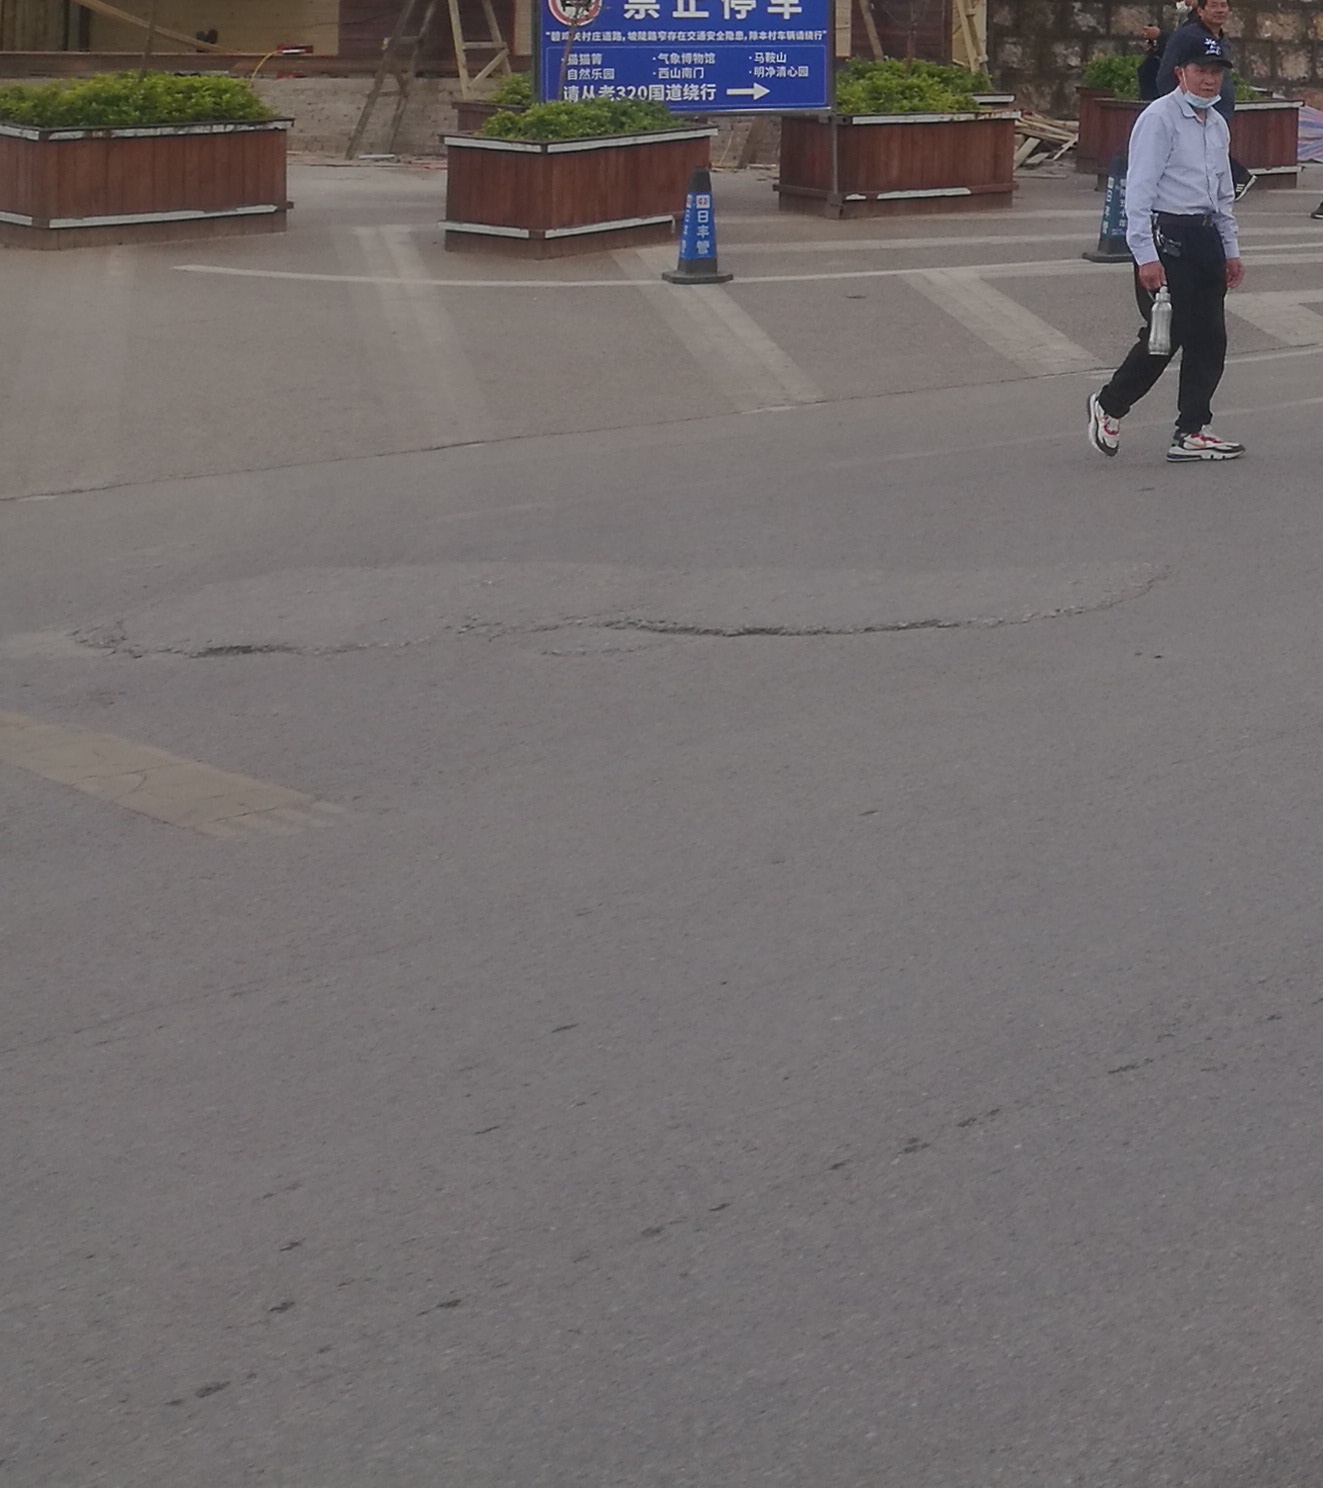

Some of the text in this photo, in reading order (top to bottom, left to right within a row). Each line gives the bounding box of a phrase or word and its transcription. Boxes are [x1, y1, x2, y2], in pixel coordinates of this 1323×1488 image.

[754, 51, 787, 64] 马鞍山
[567, 68, 615, 80] 自然乐园
[658, 67, 704, 79] 西山南门
[563, 83, 717, 102] 请从老320国道绕行
